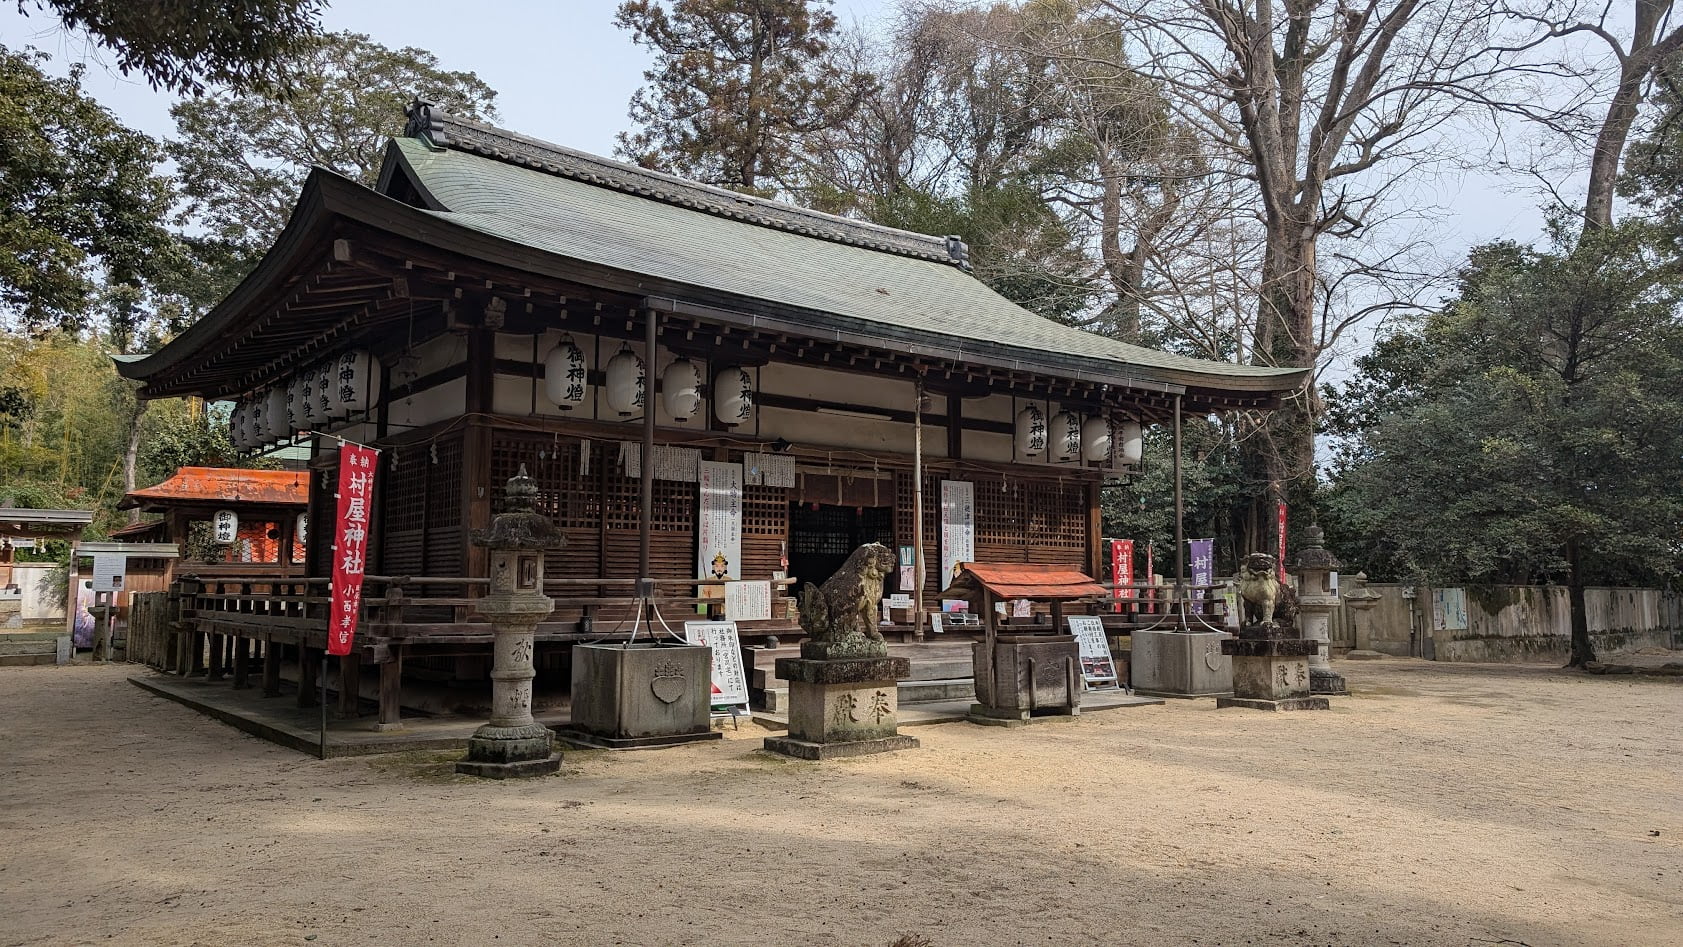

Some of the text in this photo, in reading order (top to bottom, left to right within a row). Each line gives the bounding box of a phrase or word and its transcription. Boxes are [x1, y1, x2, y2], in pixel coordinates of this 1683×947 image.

[563, 347, 585, 401] 御神燈
[218, 511, 232, 541] 御神燈
[340, 471, 367, 574] 村屋神社
